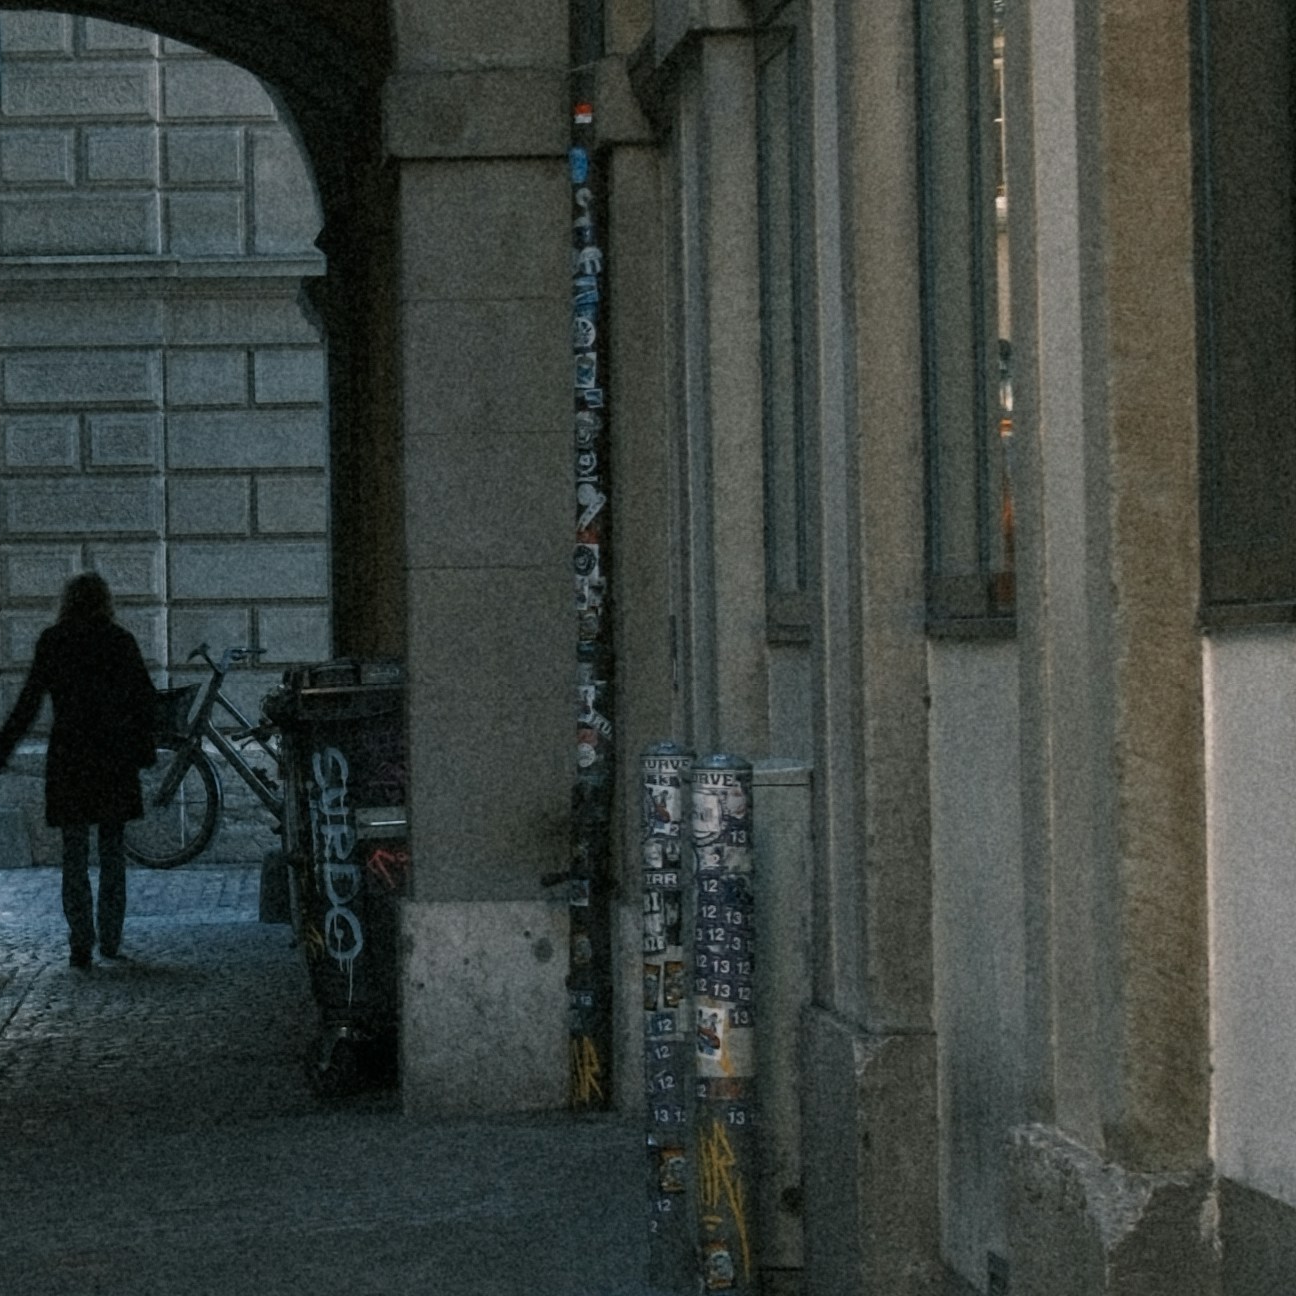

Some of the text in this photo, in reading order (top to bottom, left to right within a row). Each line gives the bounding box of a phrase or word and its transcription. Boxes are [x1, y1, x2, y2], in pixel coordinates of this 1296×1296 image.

[730, 830, 746, 843] 13
[702, 879, 718, 893] 12
[701, 905, 742, 925] 12 13
[708, 928, 725, 941] 12
[713, 960, 730, 973] 13
[714, 984, 731, 998] 13
[732, 1010, 748, 1024] 13
[657, 1018, 672, 1032] 12
[654, 1045, 671, 1059] 12
[658, 1075, 675, 1090] 12
[654, 1109, 669, 1122] 13
[728, 1111, 745, 1125] 13
[657, 1199, 672, 1212] 12
